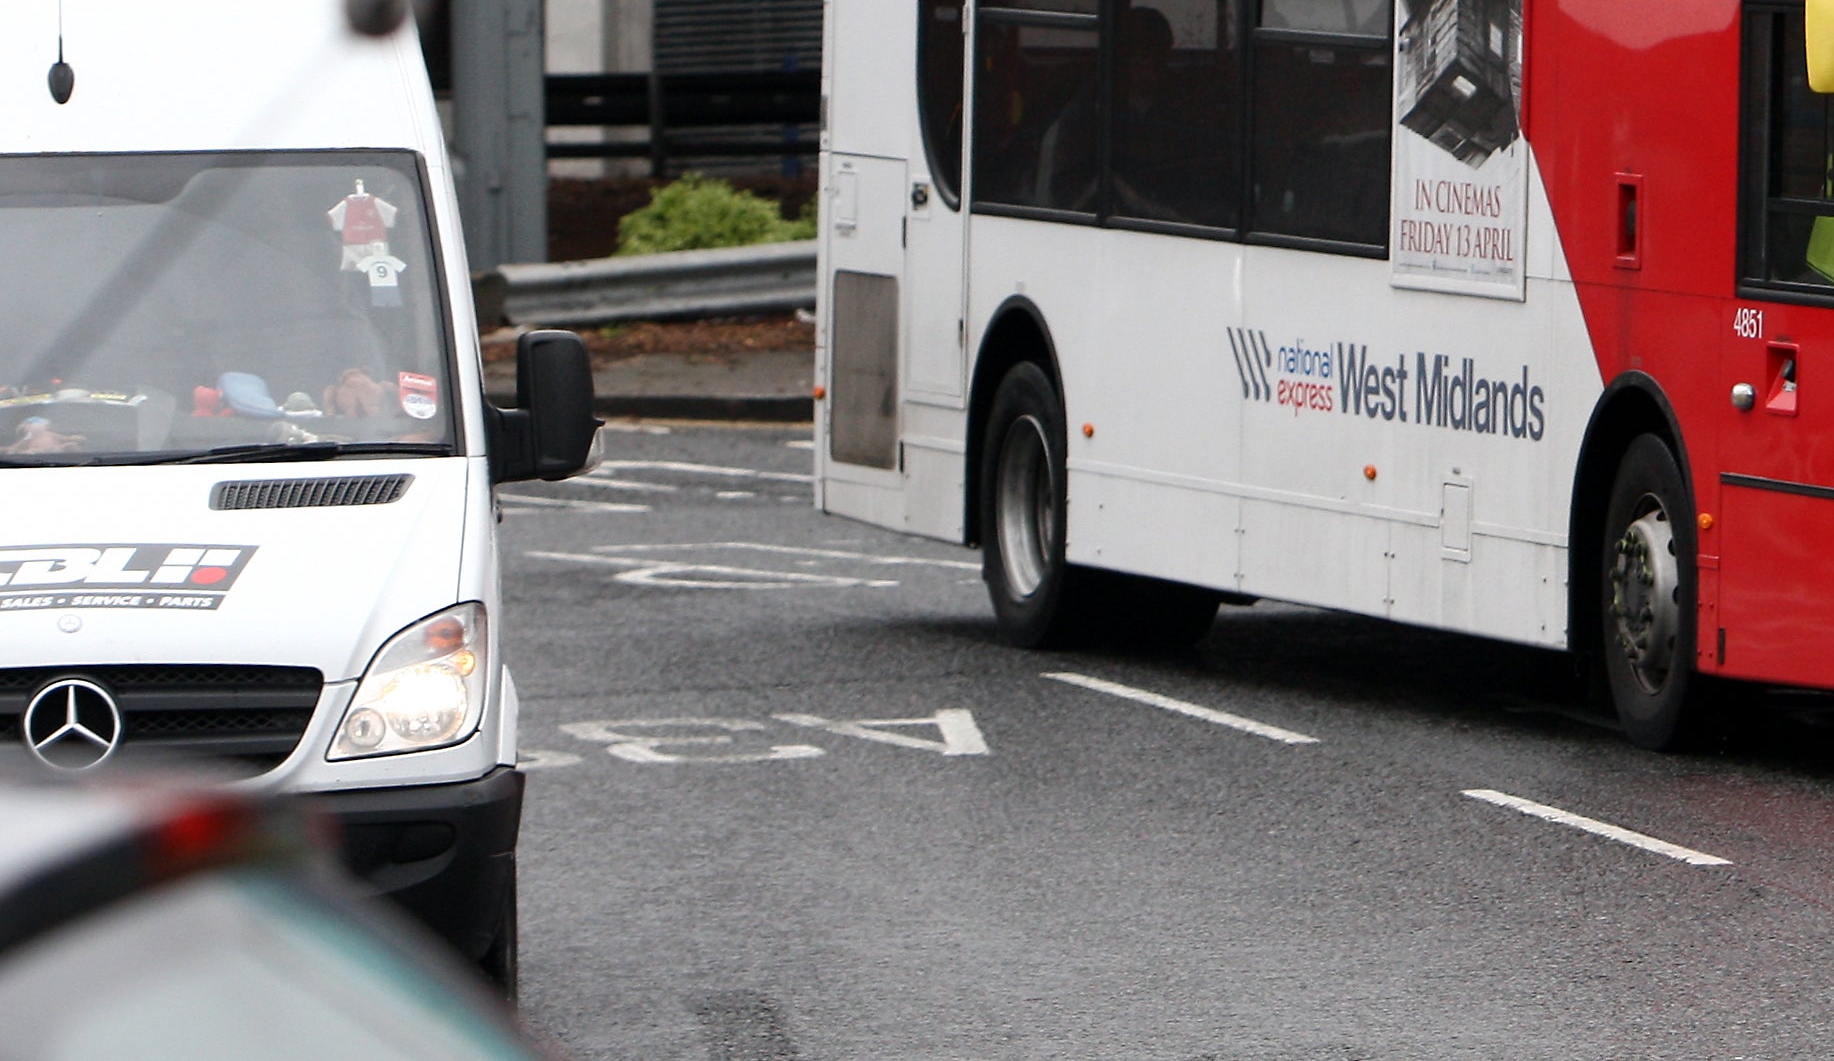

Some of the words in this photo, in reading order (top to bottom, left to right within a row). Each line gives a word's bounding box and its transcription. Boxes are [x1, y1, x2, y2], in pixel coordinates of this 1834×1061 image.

[1415, 178, 1432, 211] IN
[1436, 180, 1501, 218] CINEMAS
[1400, 219, 1452, 255] FRIDAY
[1457, 225, 1472, 257] 13
[1474, 225, 1513, 261] APRIL
[376, 265, 388, 279] 9
[1733, 307, 1763, 339] 4851
[1278, 339, 1332, 378] national
[1278, 377, 1333, 416] express
[1338, 341, 1408, 422] West
[1415, 351, 1545, 442] Midlands
[0, 596, 53, 608] SALES
[71, 595, 142, 606] SERVICE
[159, 597, 213, 607] PARTS
